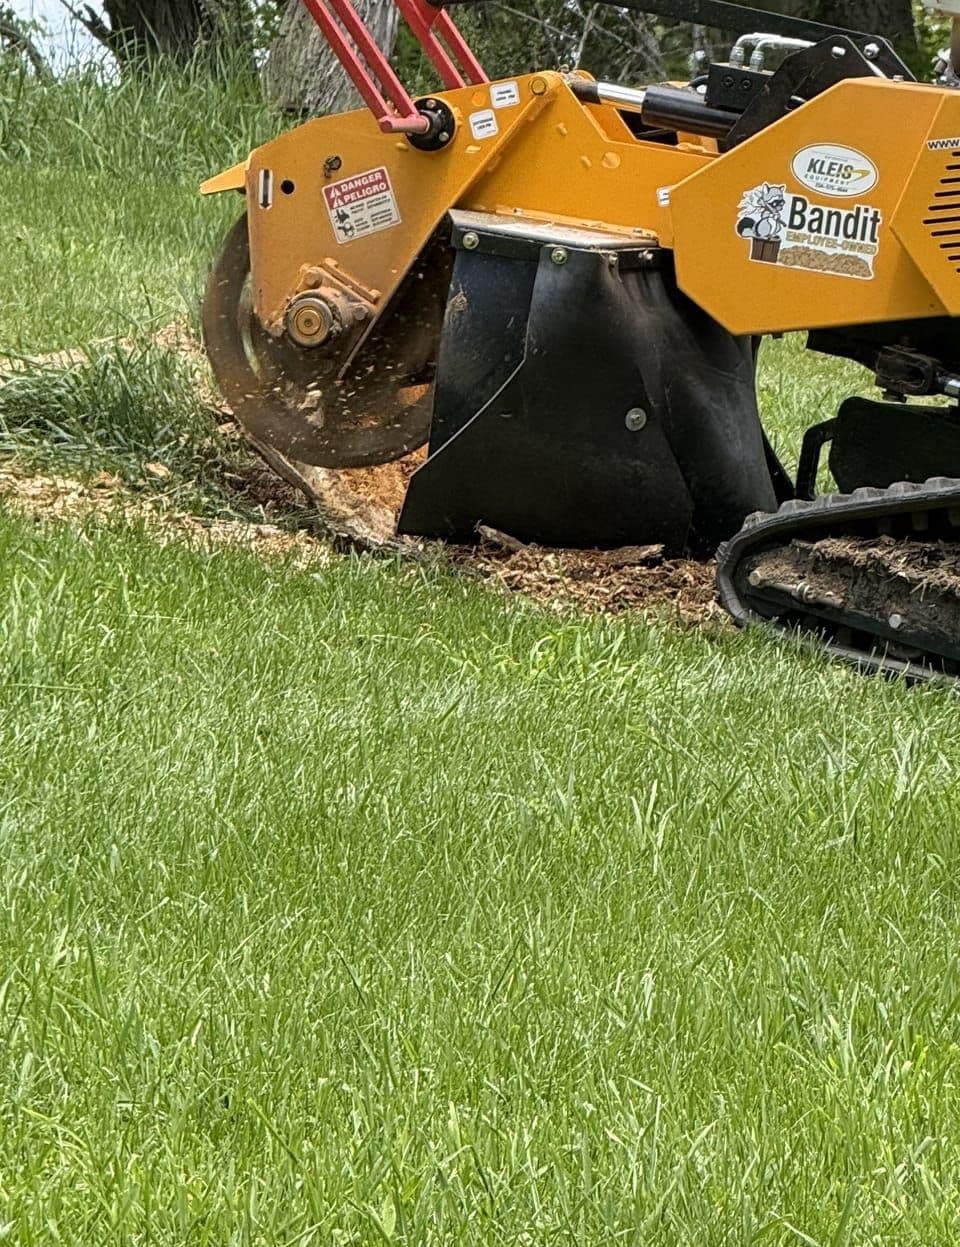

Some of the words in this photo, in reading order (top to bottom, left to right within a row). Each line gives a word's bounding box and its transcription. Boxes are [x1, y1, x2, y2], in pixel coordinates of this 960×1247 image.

[806, 157, 854, 180] KLEIS
[340, 172, 383, 193] DANGER
[343, 182, 387, 204] PELIGRO
[788, 196, 880, 244] Bandit
